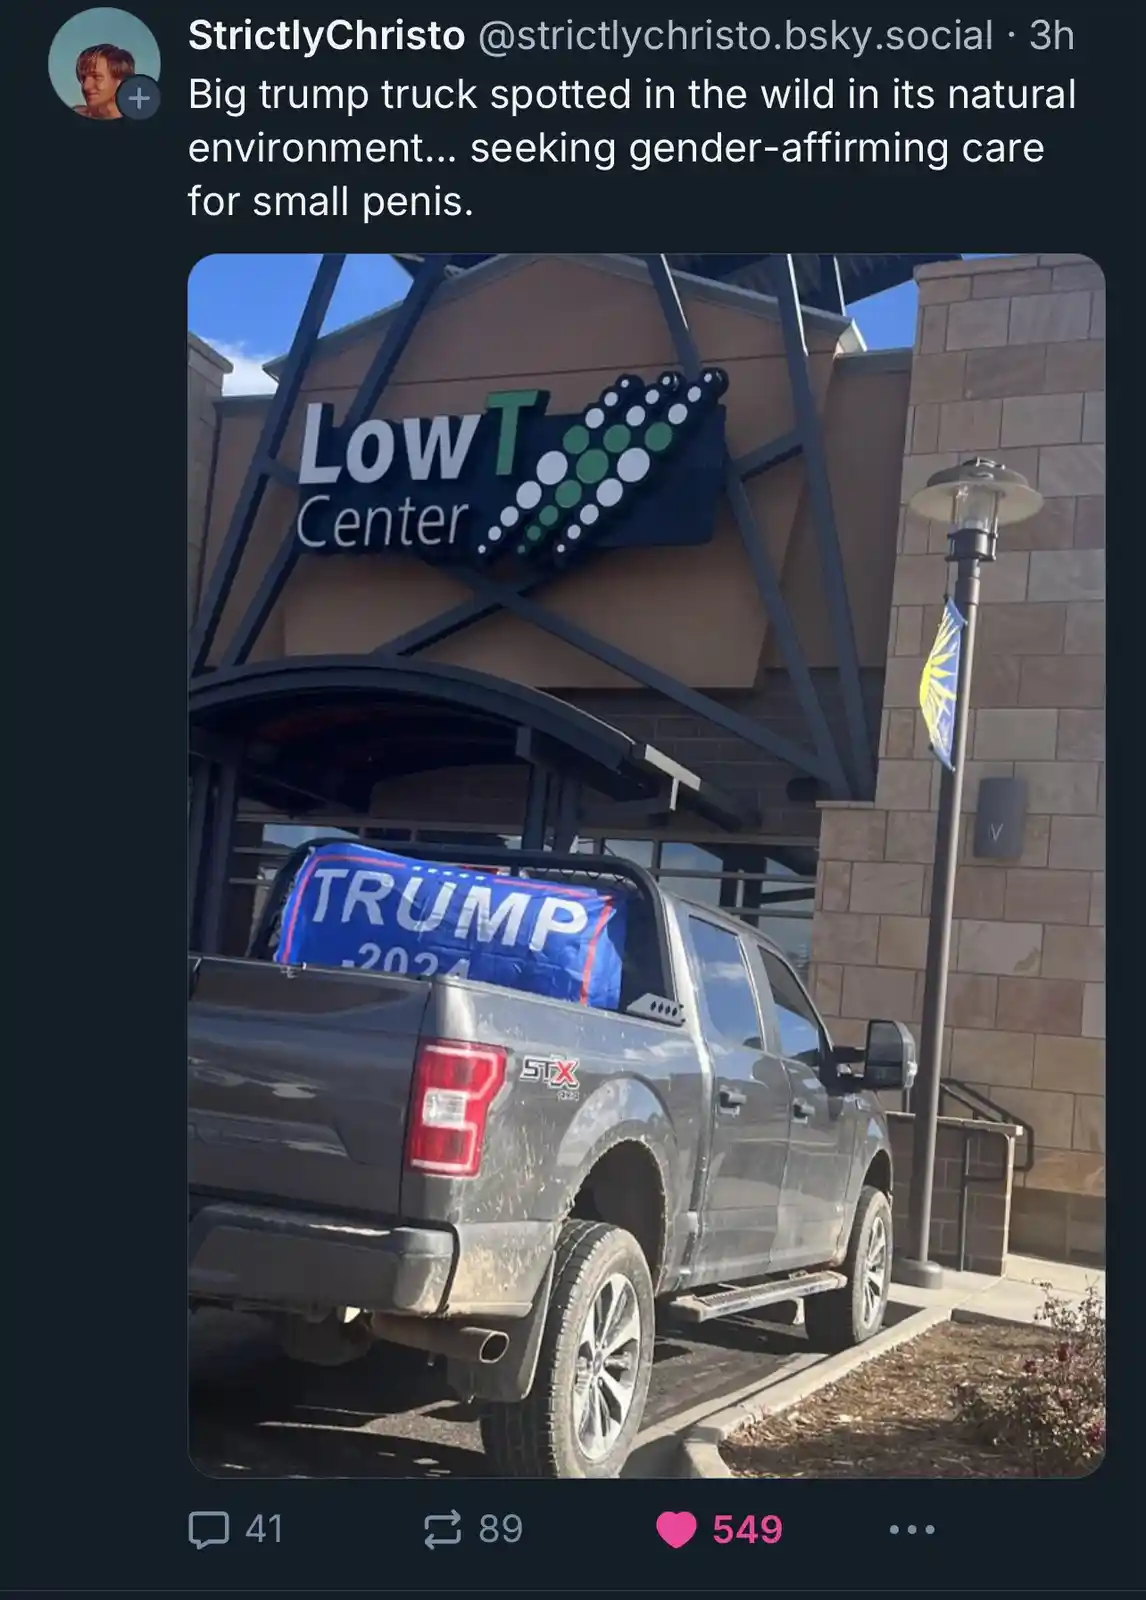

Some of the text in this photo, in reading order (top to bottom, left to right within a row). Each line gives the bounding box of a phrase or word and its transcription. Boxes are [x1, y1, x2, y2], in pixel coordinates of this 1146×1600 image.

[296, 493, 469, 548] Center
[313, 868, 589, 952] TRUMP
[519, 1054, 580, 1090] STX
